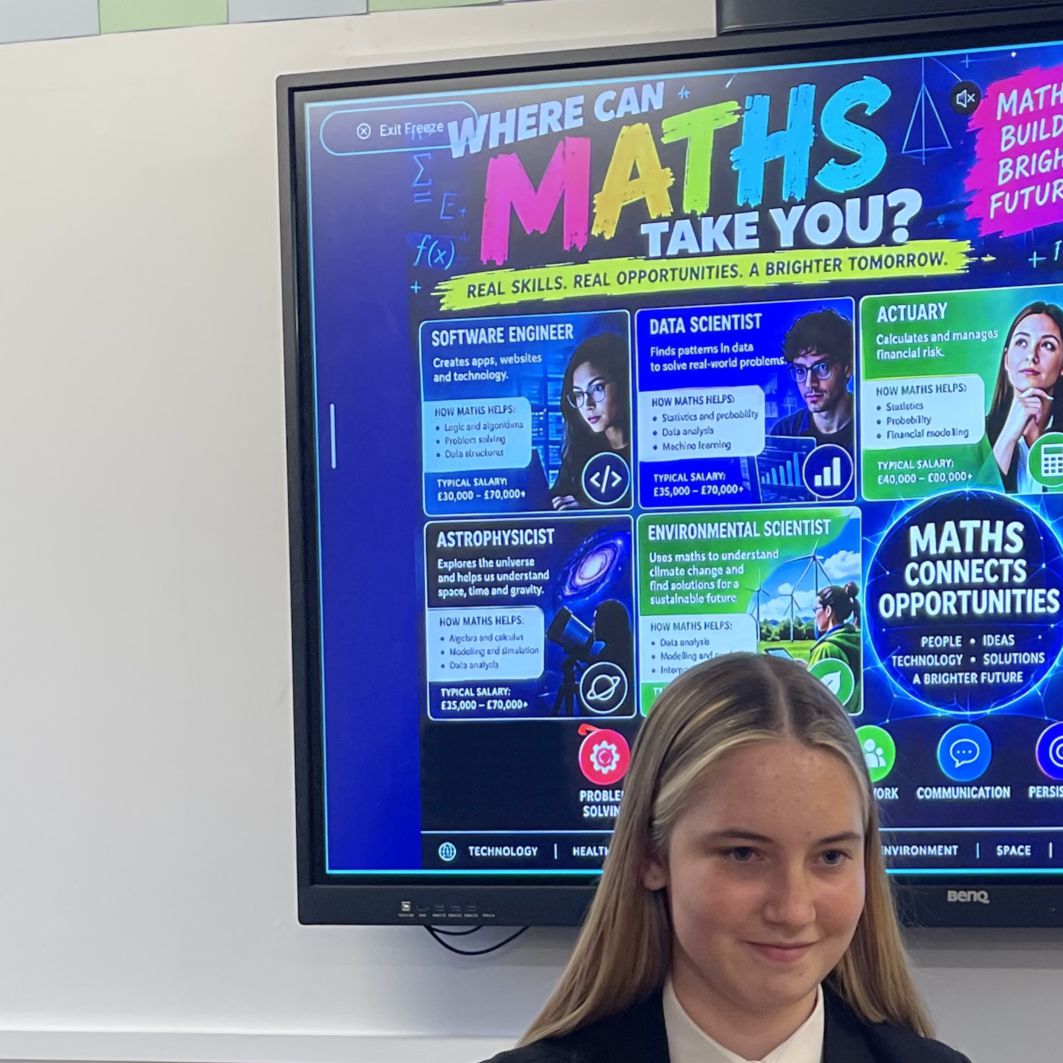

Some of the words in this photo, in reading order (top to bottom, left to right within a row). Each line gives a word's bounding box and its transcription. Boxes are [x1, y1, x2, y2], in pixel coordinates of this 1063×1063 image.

[448, 94, 585, 158] WHERE
[594, 81, 665, 122] CAN
[380, 124, 401, 137] Exit
[405, 122, 444, 135] Freeze
[480, 75, 892, 266] MATHS
[640, 211, 760, 258] TAKE
[767, 188, 923, 248] YOU?
[466, 282, 505, 299] REAL
[512, 275, 568, 294] SKILLS.
[573, 271, 610, 289] REAL
[616, 263, 744, 285] OPPORTUNITIES.
[748, 261, 760, 278] A
[765, 256, 842, 276] BRIGHTER
[848, 250, 949, 273] TOMORROW.
[876, 302, 948, 322] ACTUARY
[650, 318, 686, 335] DATA
[690, 313, 762, 332] SCIENTIST
[432, 327, 504, 346] SOFTWARE
[509, 323, 574, 342] ENGINEER
[931, 332, 950, 342] and
[732, 342, 754, 352] data
[433, 358, 470, 368] Creates
[500, 354, 542, 364] websites
[650, 362, 660, 372] to
[662, 360, 687, 370] solve
[434, 372, 452, 382] and
[648, 521, 760, 540] ENVIRONMENTAL
[764, 519, 832, 536] SCIENTIST
[436, 528, 555, 548] ASTROPHYSICIST
[910, 520, 1024, 557] MATHS
[904, 559, 1027, 586] CONNECTS
[878, 588, 1060, 618] OPPORTUNITIES
[921, 636, 962, 648] PEOPLE
[983, 634, 1015, 646] IDEAS
[892, 654, 964, 667] TECHNOLOGY
[983, 652, 1045, 664] SOLUTIONS
[912, 673, 921, 684] A
[924, 672, 978, 684] BRIGHTER
[980, 671, 1024, 683] FUTURE
[580, 790, 624, 802] PROBLE
[916, 786, 1010, 800] COMMUNICATION
[582, 805, 621, 818] SOLVIN
[468, 846, 538, 856] TECHNOLOGY
[881, 845, 958, 856] NVIRONMENT
[996, 844, 1031, 856] SPACE
[947, 890, 990, 904] BenQ
